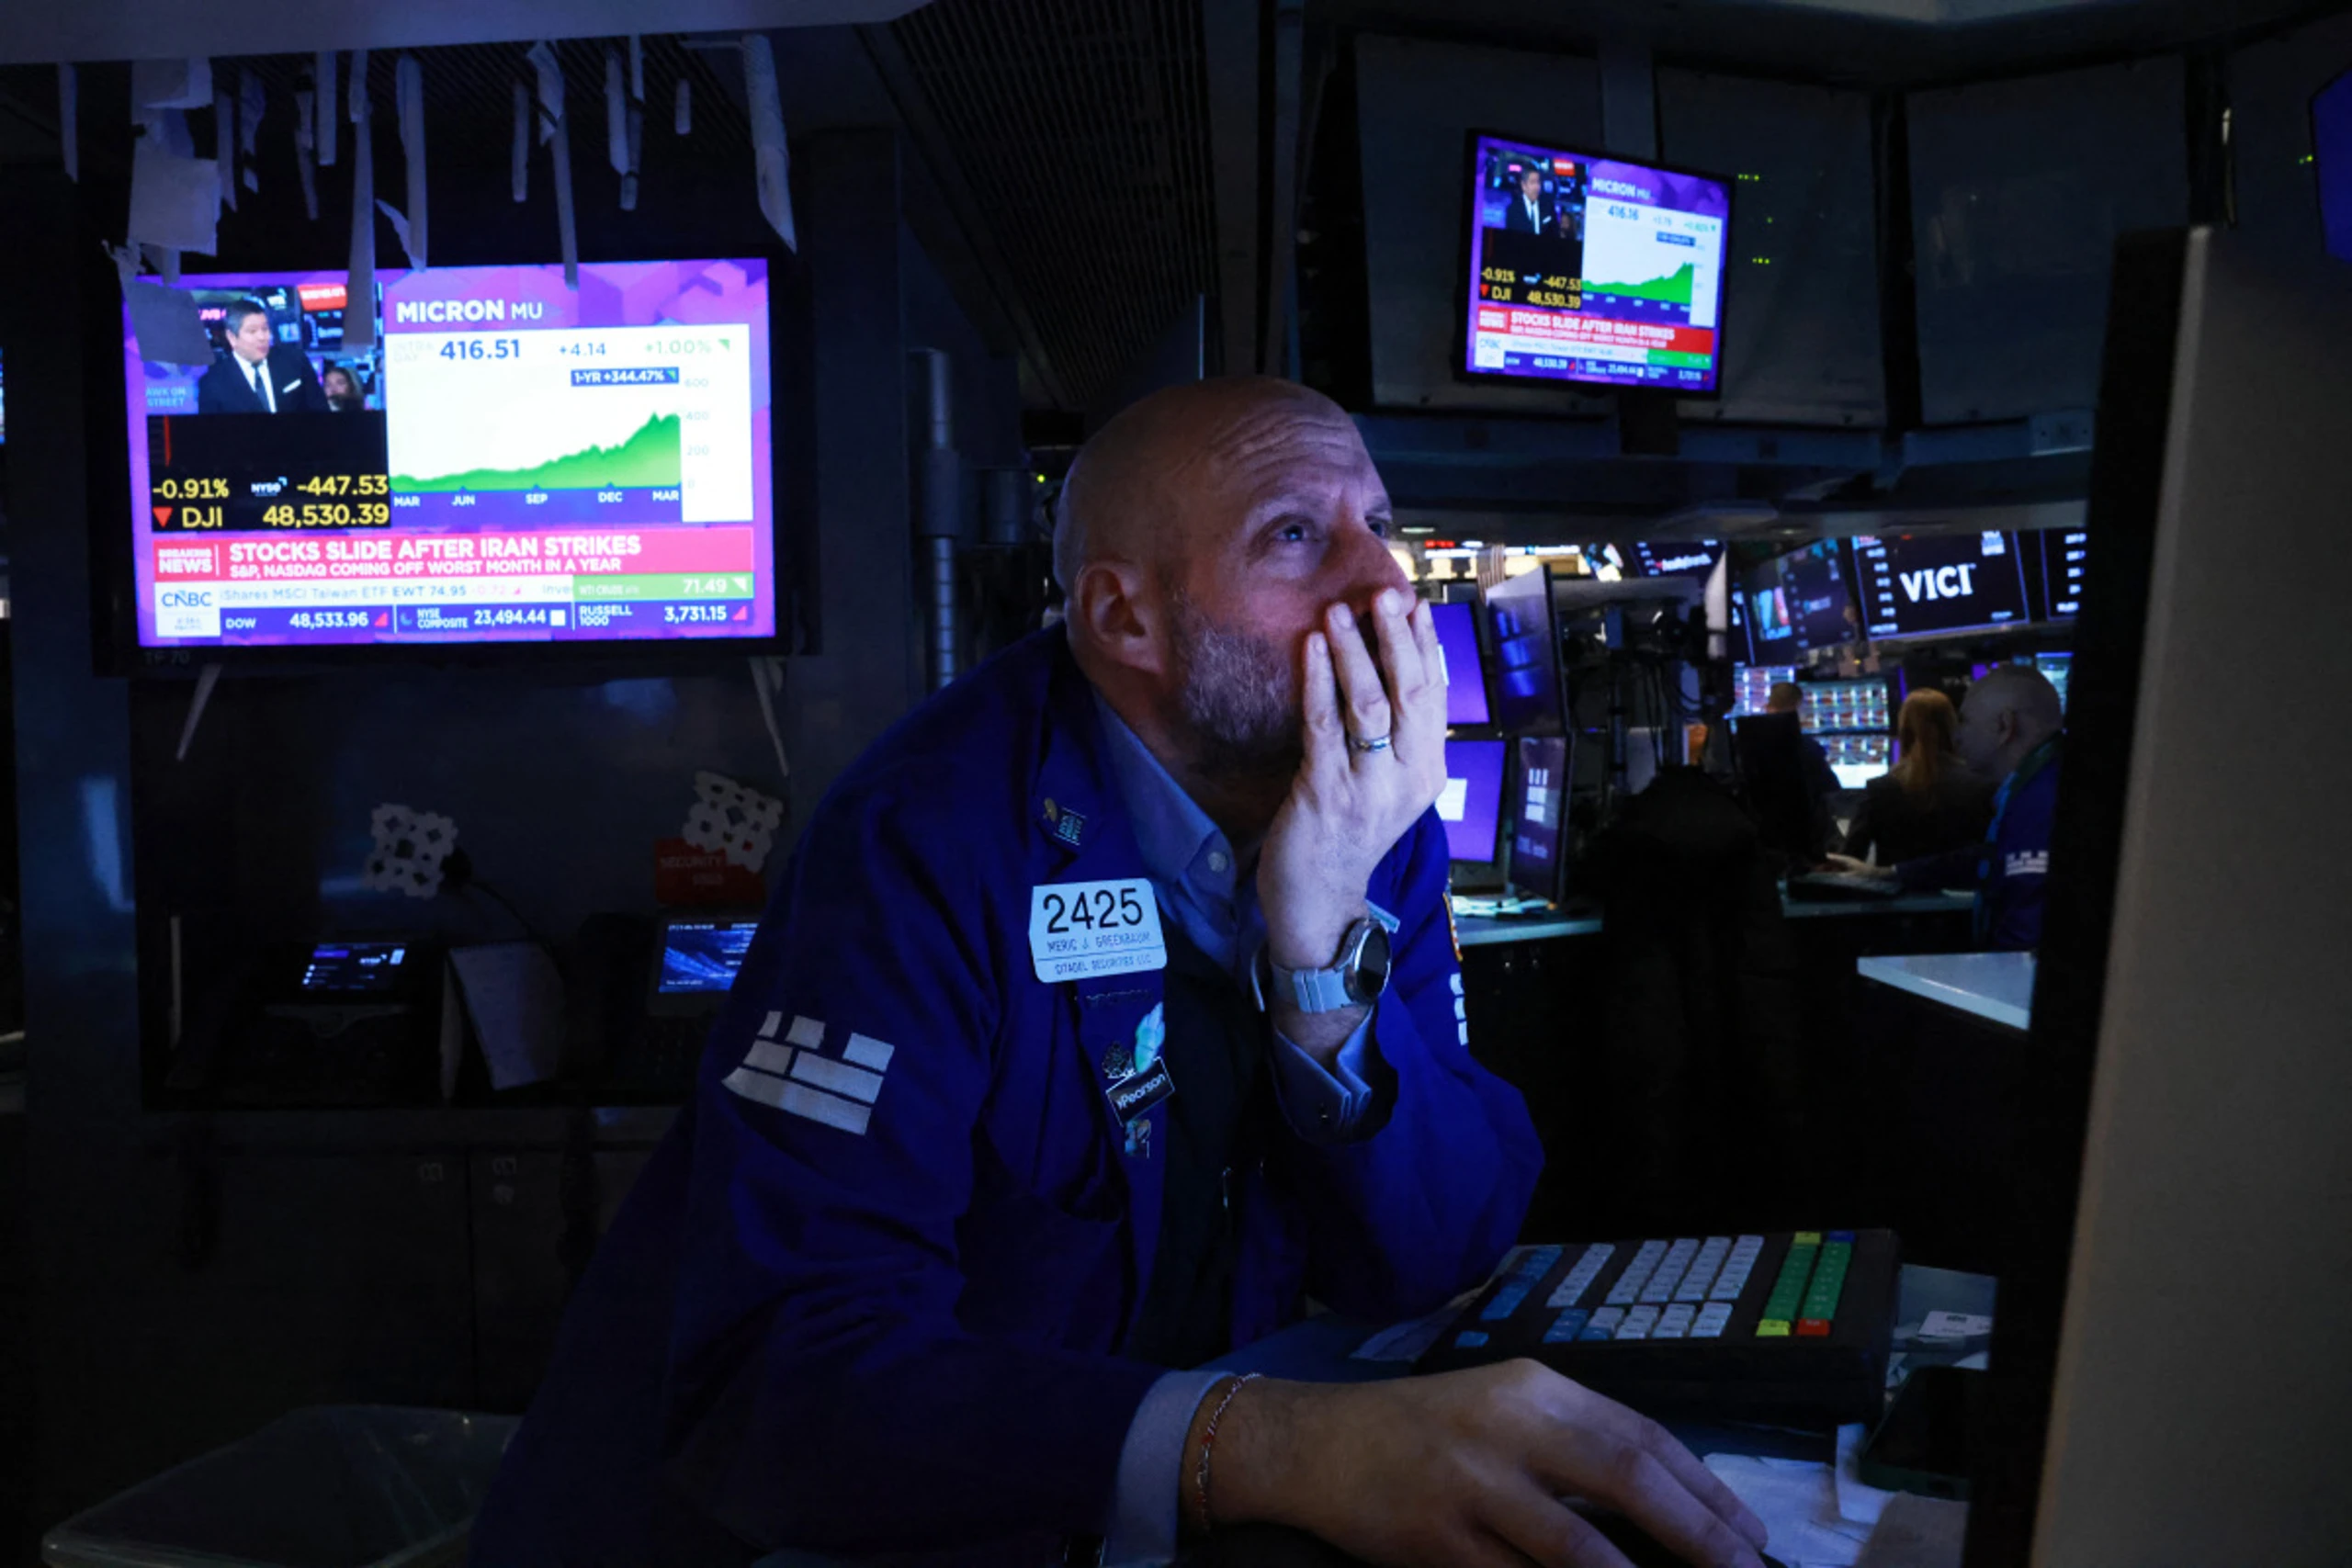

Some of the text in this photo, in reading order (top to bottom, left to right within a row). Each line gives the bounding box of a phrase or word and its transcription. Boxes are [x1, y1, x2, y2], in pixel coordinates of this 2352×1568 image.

[1591, 177, 1636, 197] MICRON
[1544, 276, 1582, 292] -447.53
[1491, 286, 1512, 301] DJI
[1527, 290, 1581, 310] 48,530.39
[396, 299, 542, 323] MICRON MU
[1510, 311, 1551, 327] STOCKS
[1552, 315, 1580, 330] SLIDE
[1581, 319, 1612, 333] AFTER
[439, 339, 712, 360] 416.51 +4.14 +1.00%
[574, 371, 601, 384] 1-YR
[153, 479, 230, 500] -0.91%
[297, 474, 389, 497] -447.53
[394, 495, 420, 507] MAR
[452, 494, 476, 506] JUN
[526, 492, 548, 505] SEP
[598, 491, 623, 503] DEC
[652, 490, 679, 502] MAR
[182, 502, 390, 528] DJI 48,530.39
[230, 535, 641, 562] STOCKS SLIDE AFTER IRAN STRIKES
[158, 558, 212, 573] NEWS
[230, 558, 621, 579] S&P, NASDAQ COMING OFF WORST MONTH IN A YEAR
[362, 586, 390, 599] ETF
[392, 585, 424, 598] EWT
[430, 584, 468, 597] 74.95
[683, 577, 728, 594] 71.49
[1899, 564, 1973, 604] VICI
[161, 590, 213, 608] CNBC
[474, 609, 546, 626] 23,494.44
[580, 604, 633, 616] RUSSELL
[663, 605, 727, 624] 3,731.15
[226, 612, 368, 629] DOW 48,533.96
[580, 615, 609, 626] 1000
[1043, 888, 1144, 933] 2425
